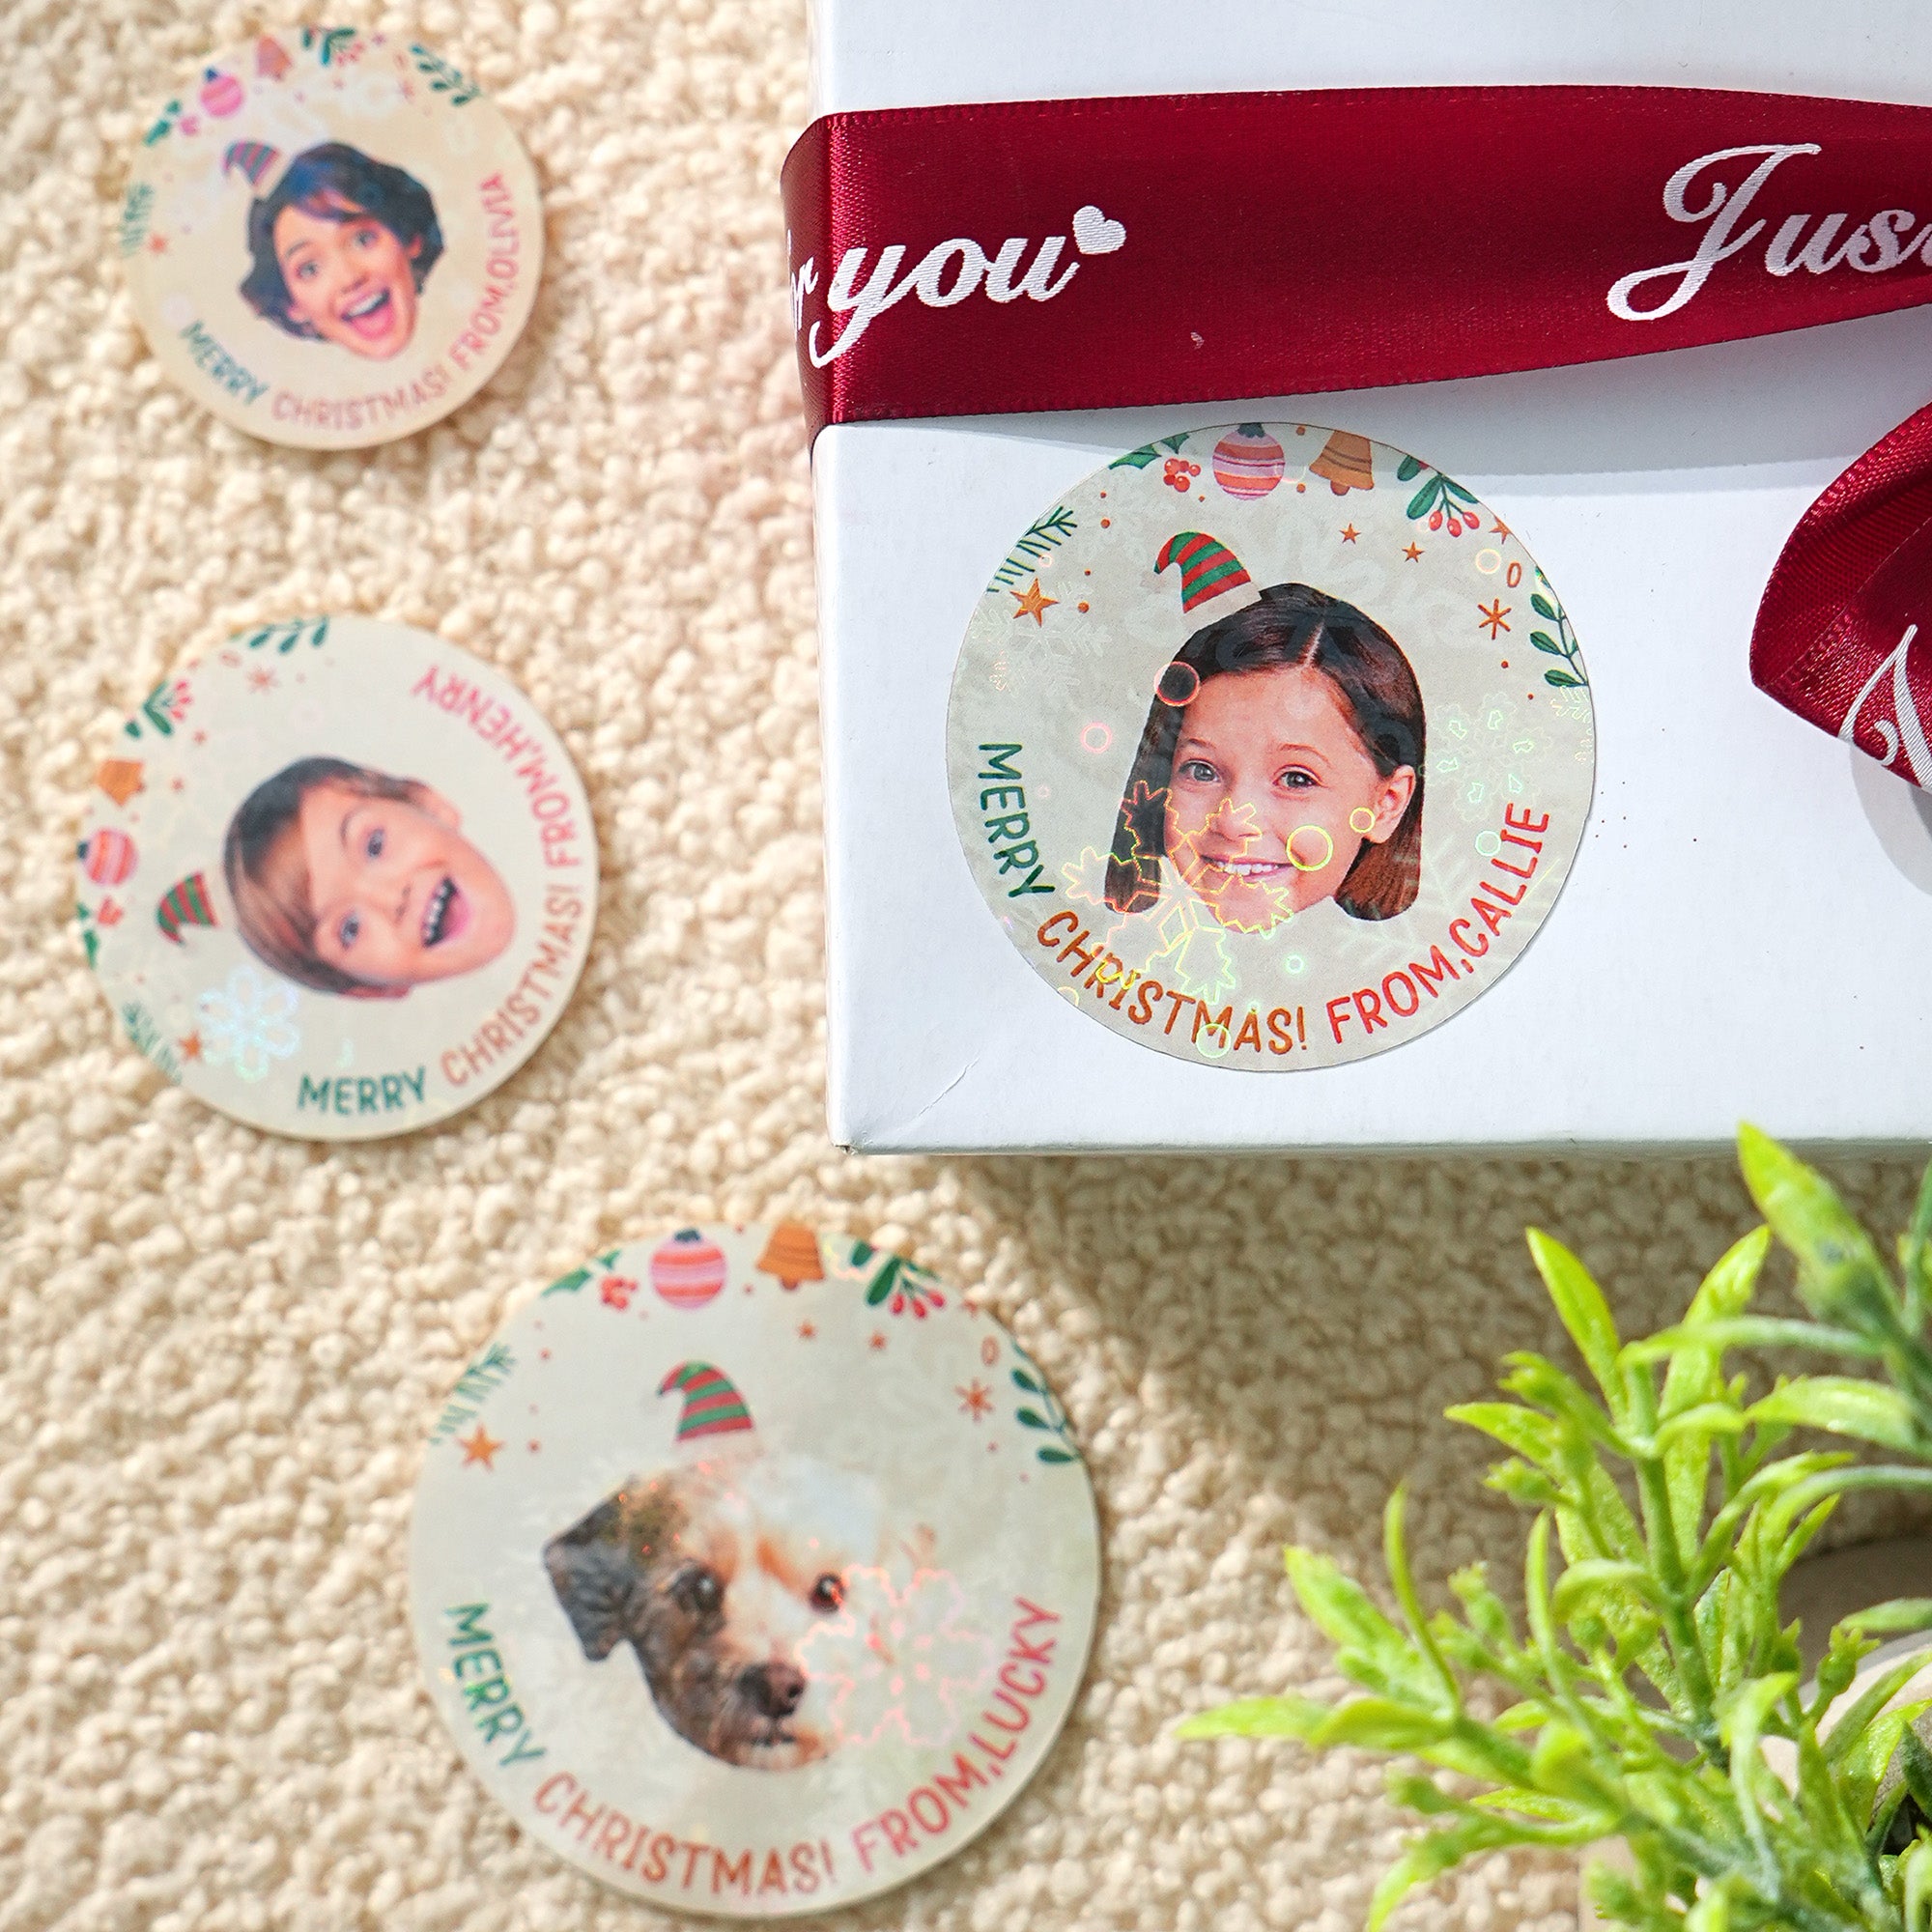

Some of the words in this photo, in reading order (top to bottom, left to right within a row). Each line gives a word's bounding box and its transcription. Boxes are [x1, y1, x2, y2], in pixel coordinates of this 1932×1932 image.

[809, 236, 1080, 369] you
[1605, 142, 1932, 321] Jus
[180, 320, 269, 406] MERRY
[271, 367, 453, 431] CHRISTMAS!
[297, 1066, 427, 1116] MERRY
[440, 883, 583, 1087] CHRISTMAS!
[978, 743, 1056, 899] MERRY
[1037, 911, 1308, 1055] CHRISTMAS!
[443, 1602, 545, 1769] MERRY
[534, 1772, 834, 1896] CHRISTMAS!
